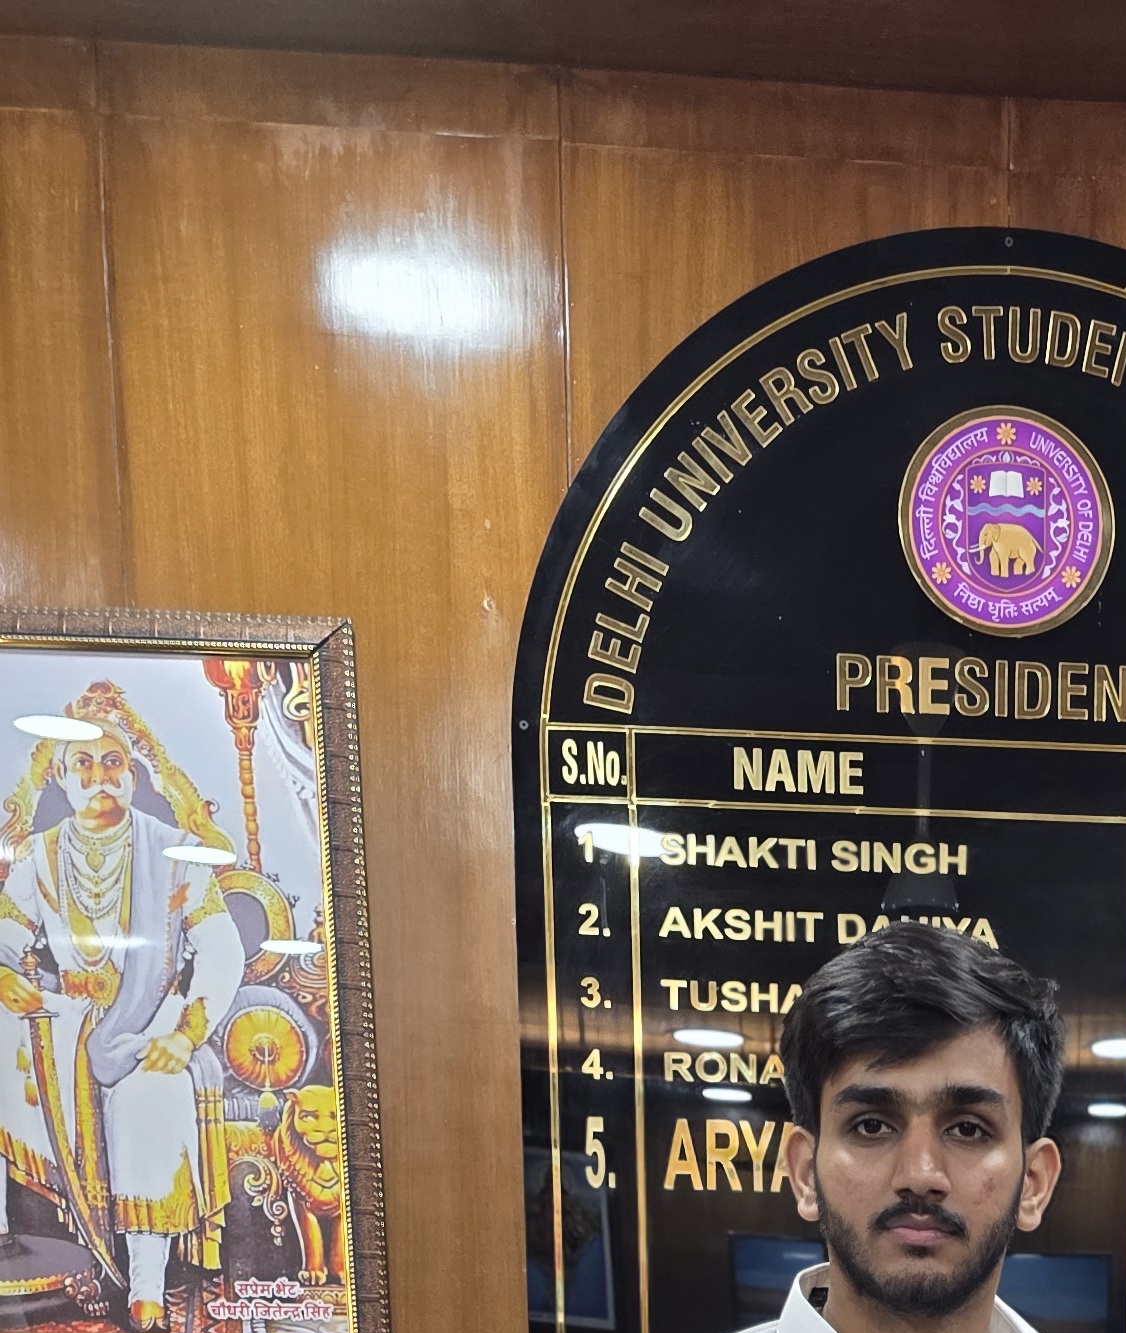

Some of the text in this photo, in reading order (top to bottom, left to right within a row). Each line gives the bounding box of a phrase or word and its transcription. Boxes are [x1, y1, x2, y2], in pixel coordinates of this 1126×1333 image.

[583, 541, 670, 714] DELHI
[640, 312, 912, 544] UNIVERSITY
[916, 427, 988, 560] दिल्ली विश्वविद्यालय
[1029, 431, 1094, 563] UNIVERSITY OF DELHI
[561, 738, 628, 786] S.No.
[733, 747, 864, 795] NAME
[659, 833, 967, 876] SHAKTI SINGH
[578, 903, 611, 937] 2.
[658, 907, 824, 943] AKSHIT
[579, 977, 612, 1008] 3.
[582, 1049, 614, 1080] 4.
[585, 1116, 616, 1188] 5.
[236, 1277, 272, 1297] सप्रेम
[208, 1299, 250, 1320] चौधरी
[304, 1299, 333, 1321] सिंह
